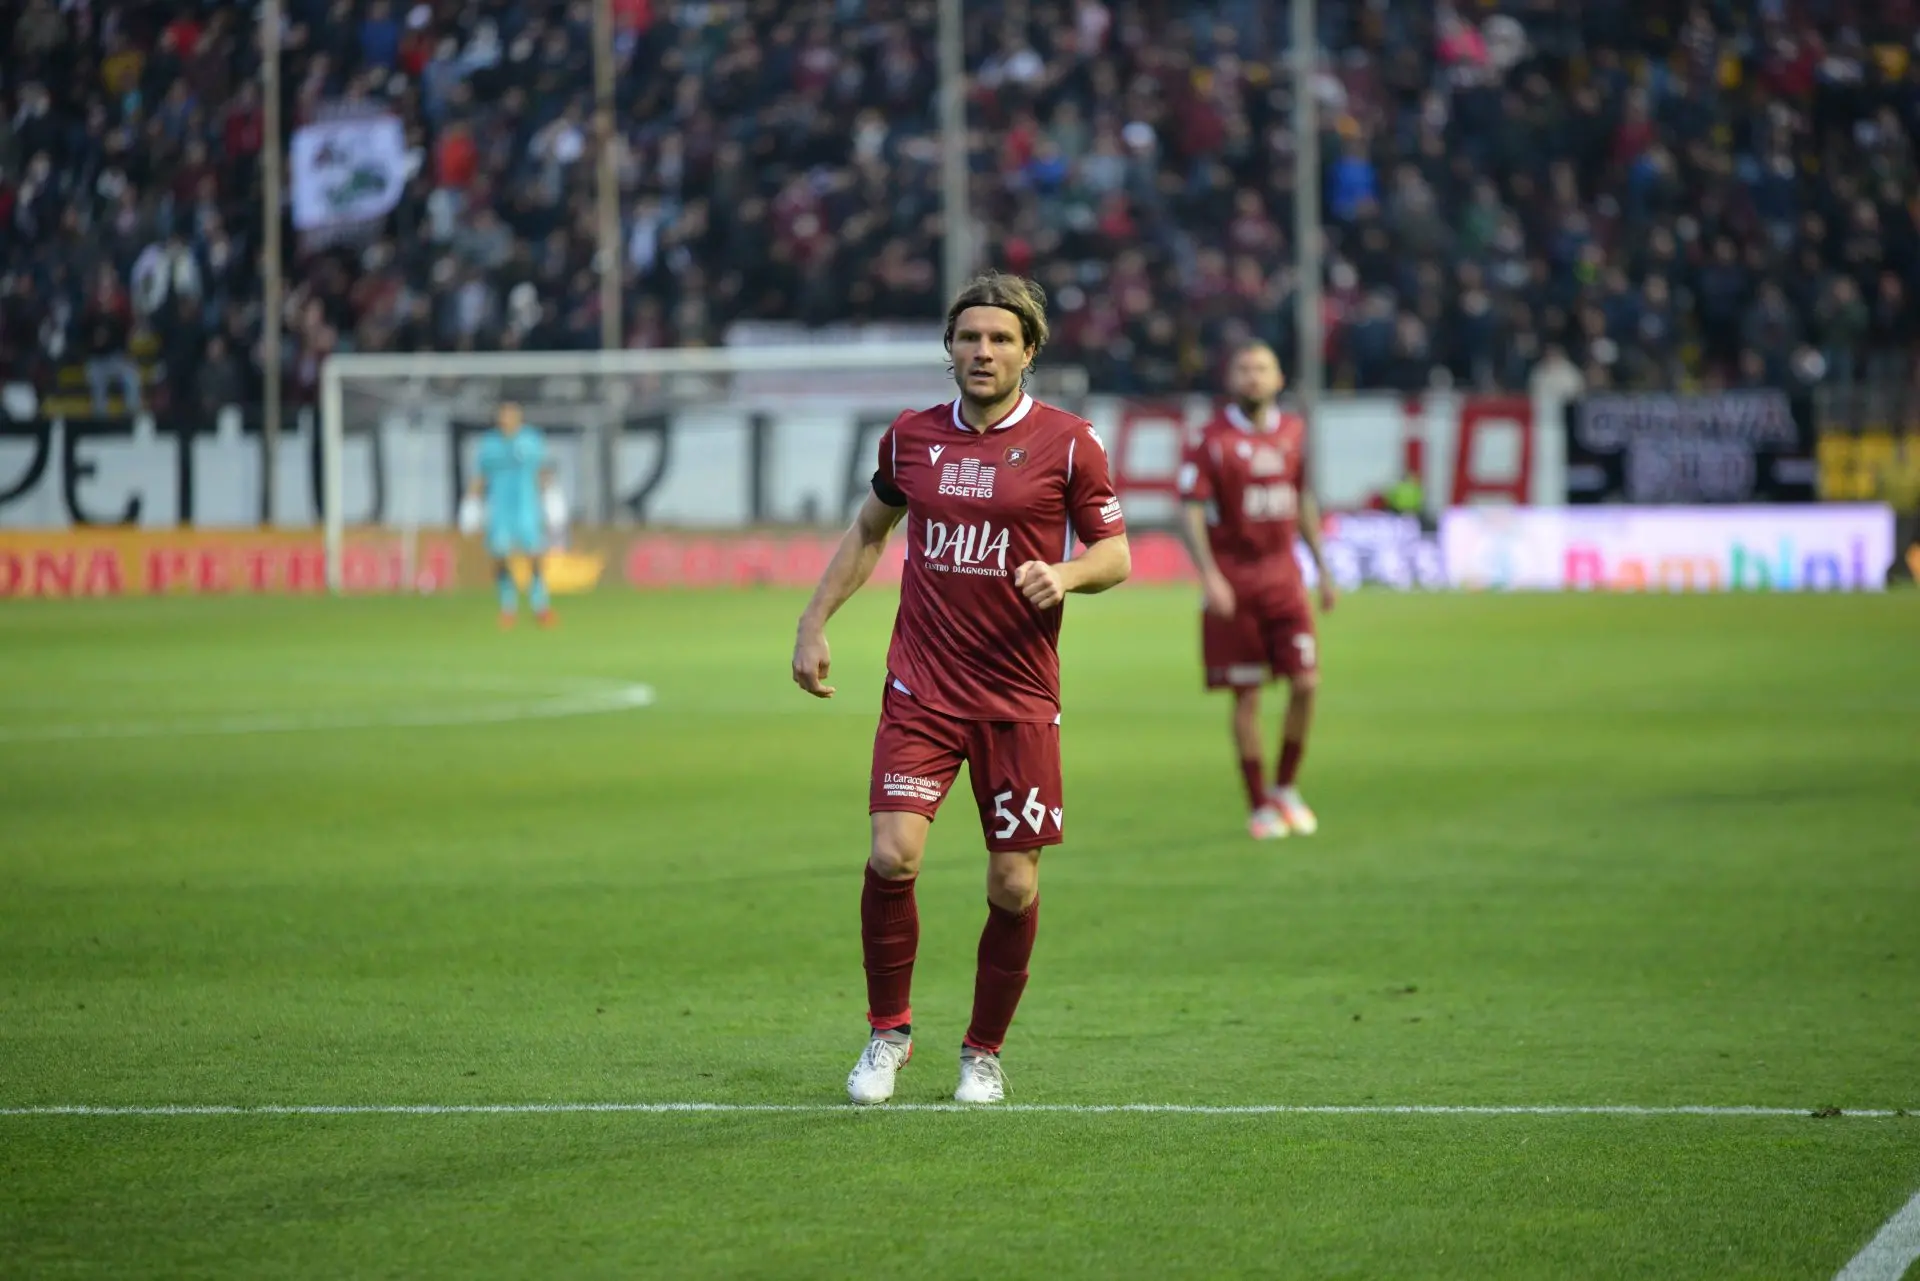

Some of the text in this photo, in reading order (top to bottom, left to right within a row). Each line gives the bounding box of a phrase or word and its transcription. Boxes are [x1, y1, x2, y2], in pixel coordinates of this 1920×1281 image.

[937, 484, 993, 499] SOSETEG
[923, 517, 1010, 570] DALIA
[924, 561, 1008, 578] CENTRO DIAGNOSTICO
[884, 772, 892, 783] D.
[893, 773, 931, 788] Caracciolo
[994, 786, 1046, 839] 56
